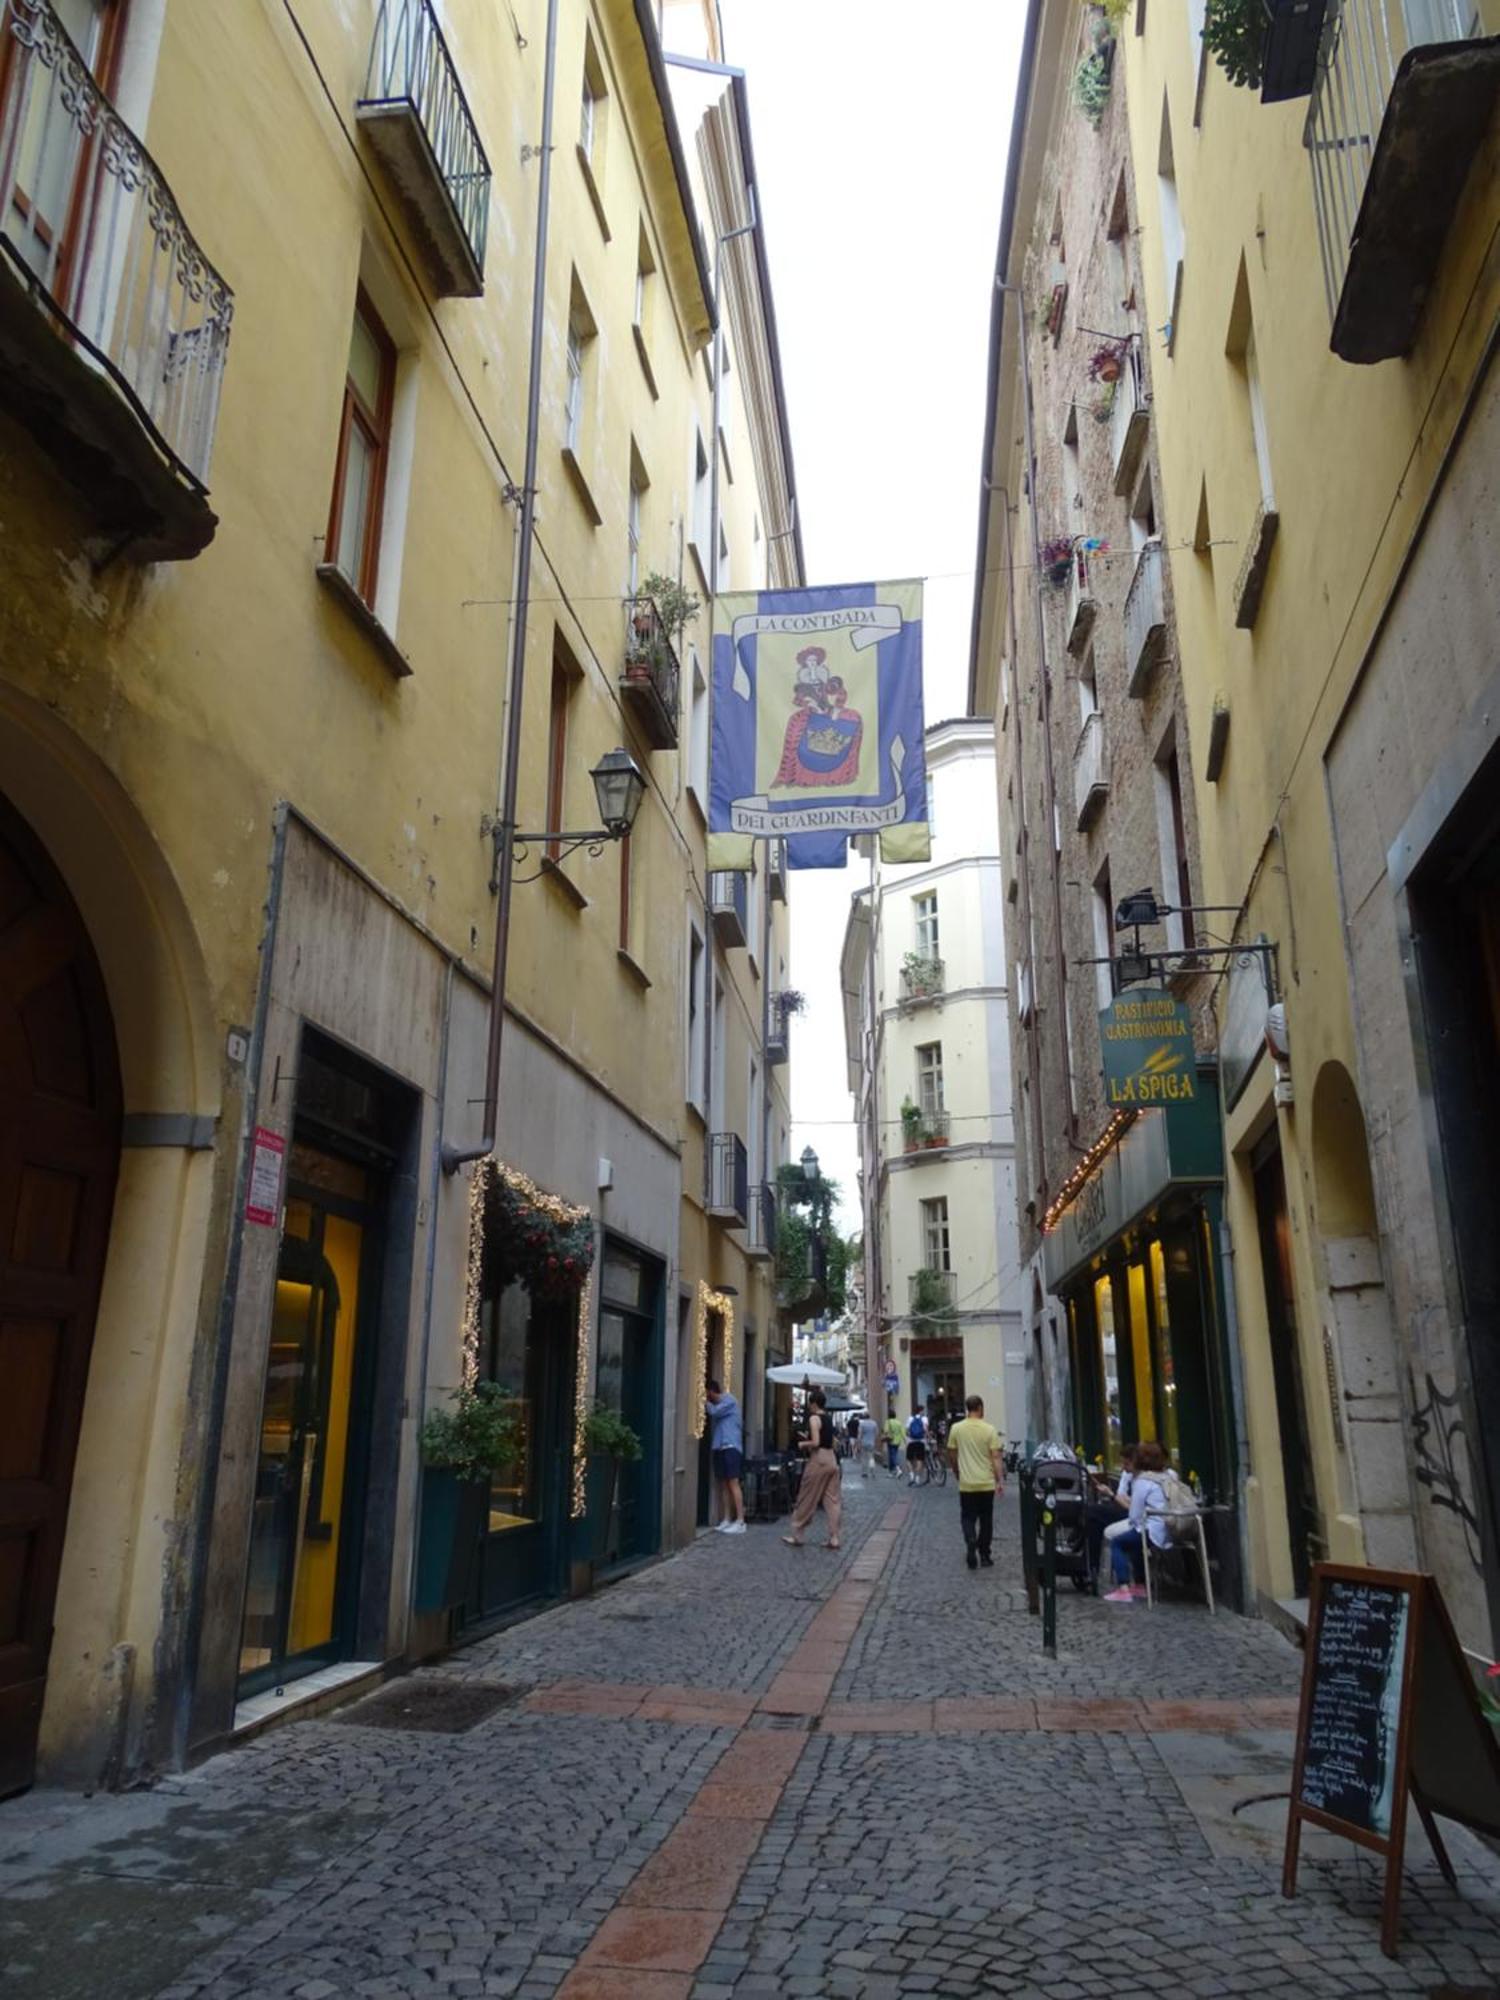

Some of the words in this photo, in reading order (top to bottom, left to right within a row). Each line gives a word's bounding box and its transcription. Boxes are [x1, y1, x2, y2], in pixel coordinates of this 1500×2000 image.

[755, 617, 778, 632] LA
[781, 610, 877, 631] CONTRADA
[737, 812, 766, 829] DEI
[771, 806, 899, 829] GUARDINFANTI
[1114, 1000, 1176, 1021] PASTIFICIO
[1106, 1020, 1187, 1041] GASTRONOMIA
[1111, 1078, 1136, 1102] LA
[1139, 1073, 1194, 1101] SPIGA
